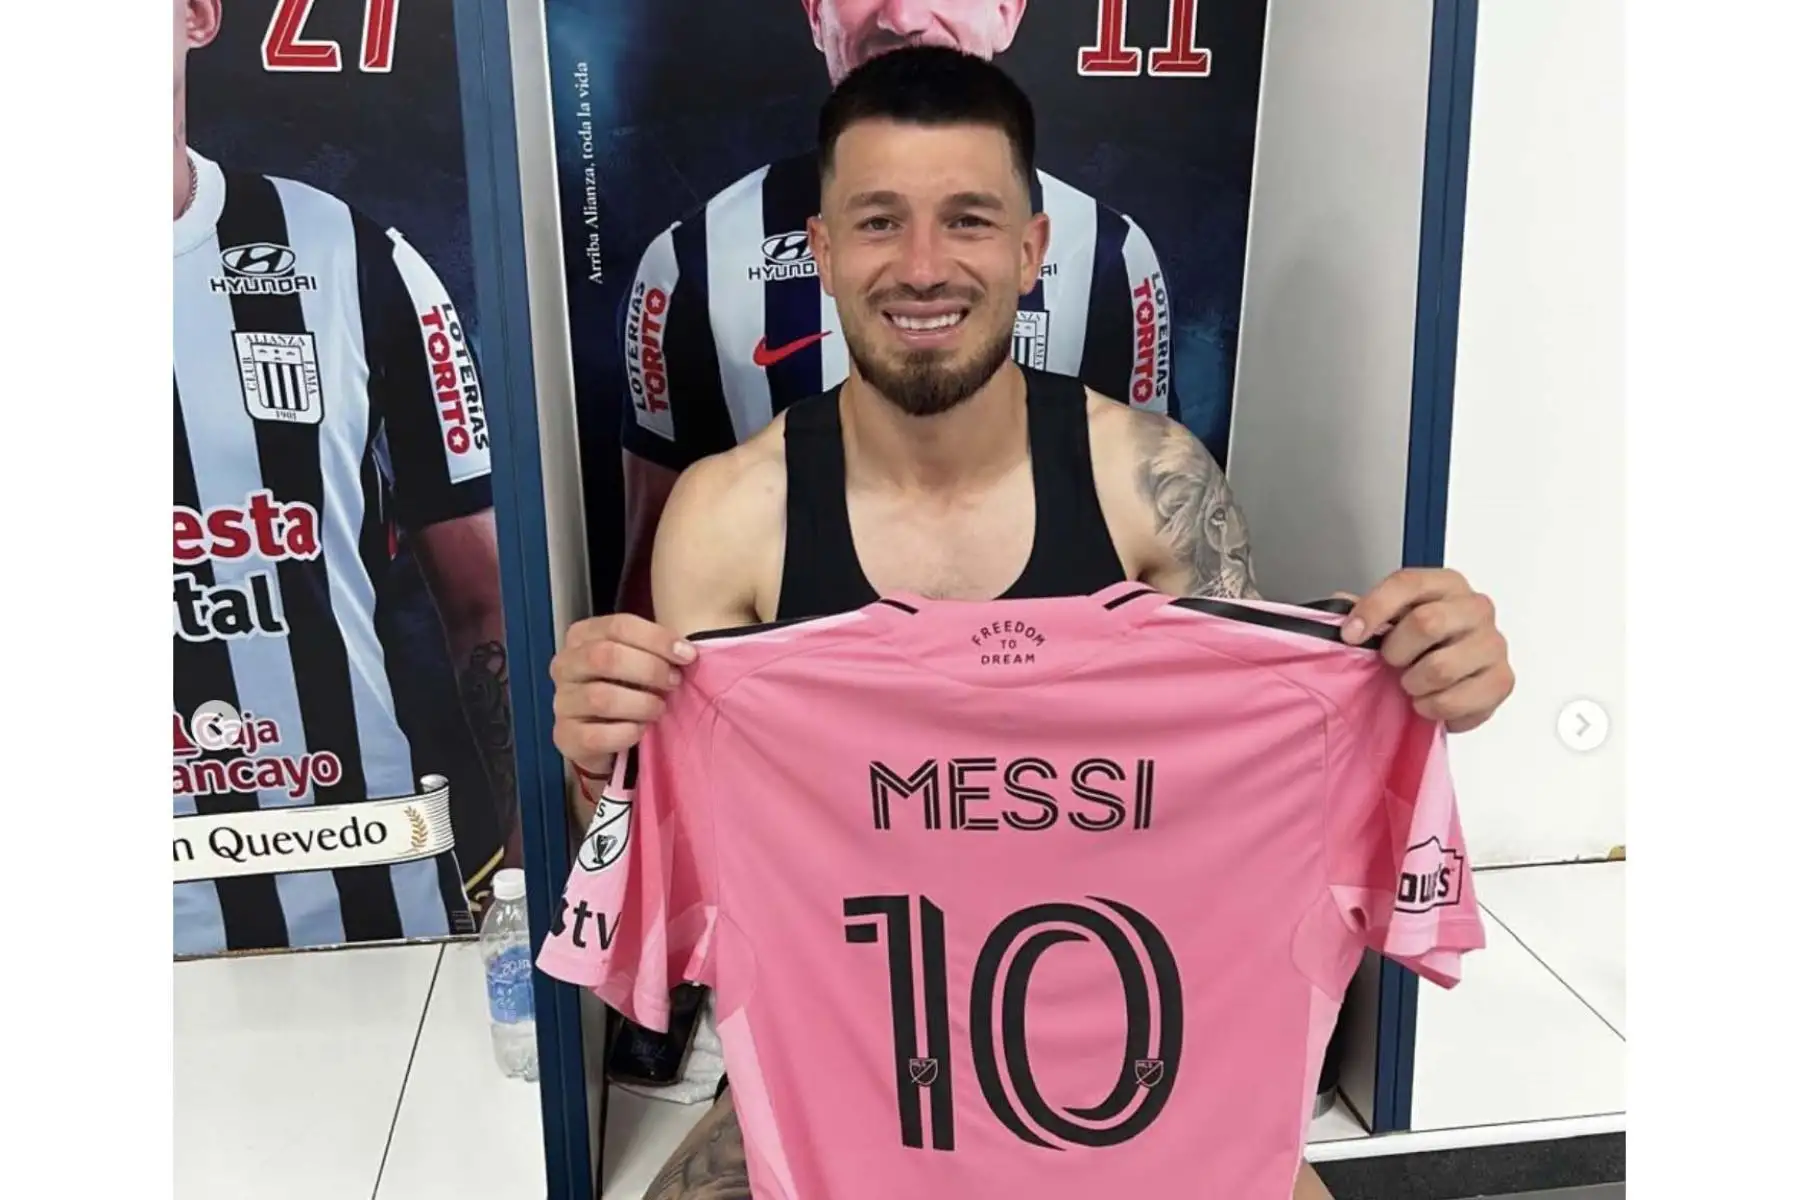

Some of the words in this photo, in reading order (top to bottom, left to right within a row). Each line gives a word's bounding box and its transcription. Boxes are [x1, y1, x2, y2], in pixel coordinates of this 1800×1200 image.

[574, 62, 590, 98] vida
[576, 102, 592, 117] la
[577, 121, 594, 159] toda
[586, 233, 603, 284] Arriba
[748, 262, 818, 281] HYUND
[209, 274, 318, 295] HYUNDAI
[640, 287, 668, 415] TORITO
[1133, 277, 1155, 403] TORITO
[420, 305, 471, 456] TORITO
[971, 620, 1046, 647] FREEDOM
[1000, 639, 1018, 650] TO
[981, 653, 1035, 665] DREAM
[869, 757, 1155, 832] MESSI
[208, 816, 388, 863] Quevedo
[843, 895, 1184, 1151] 10
